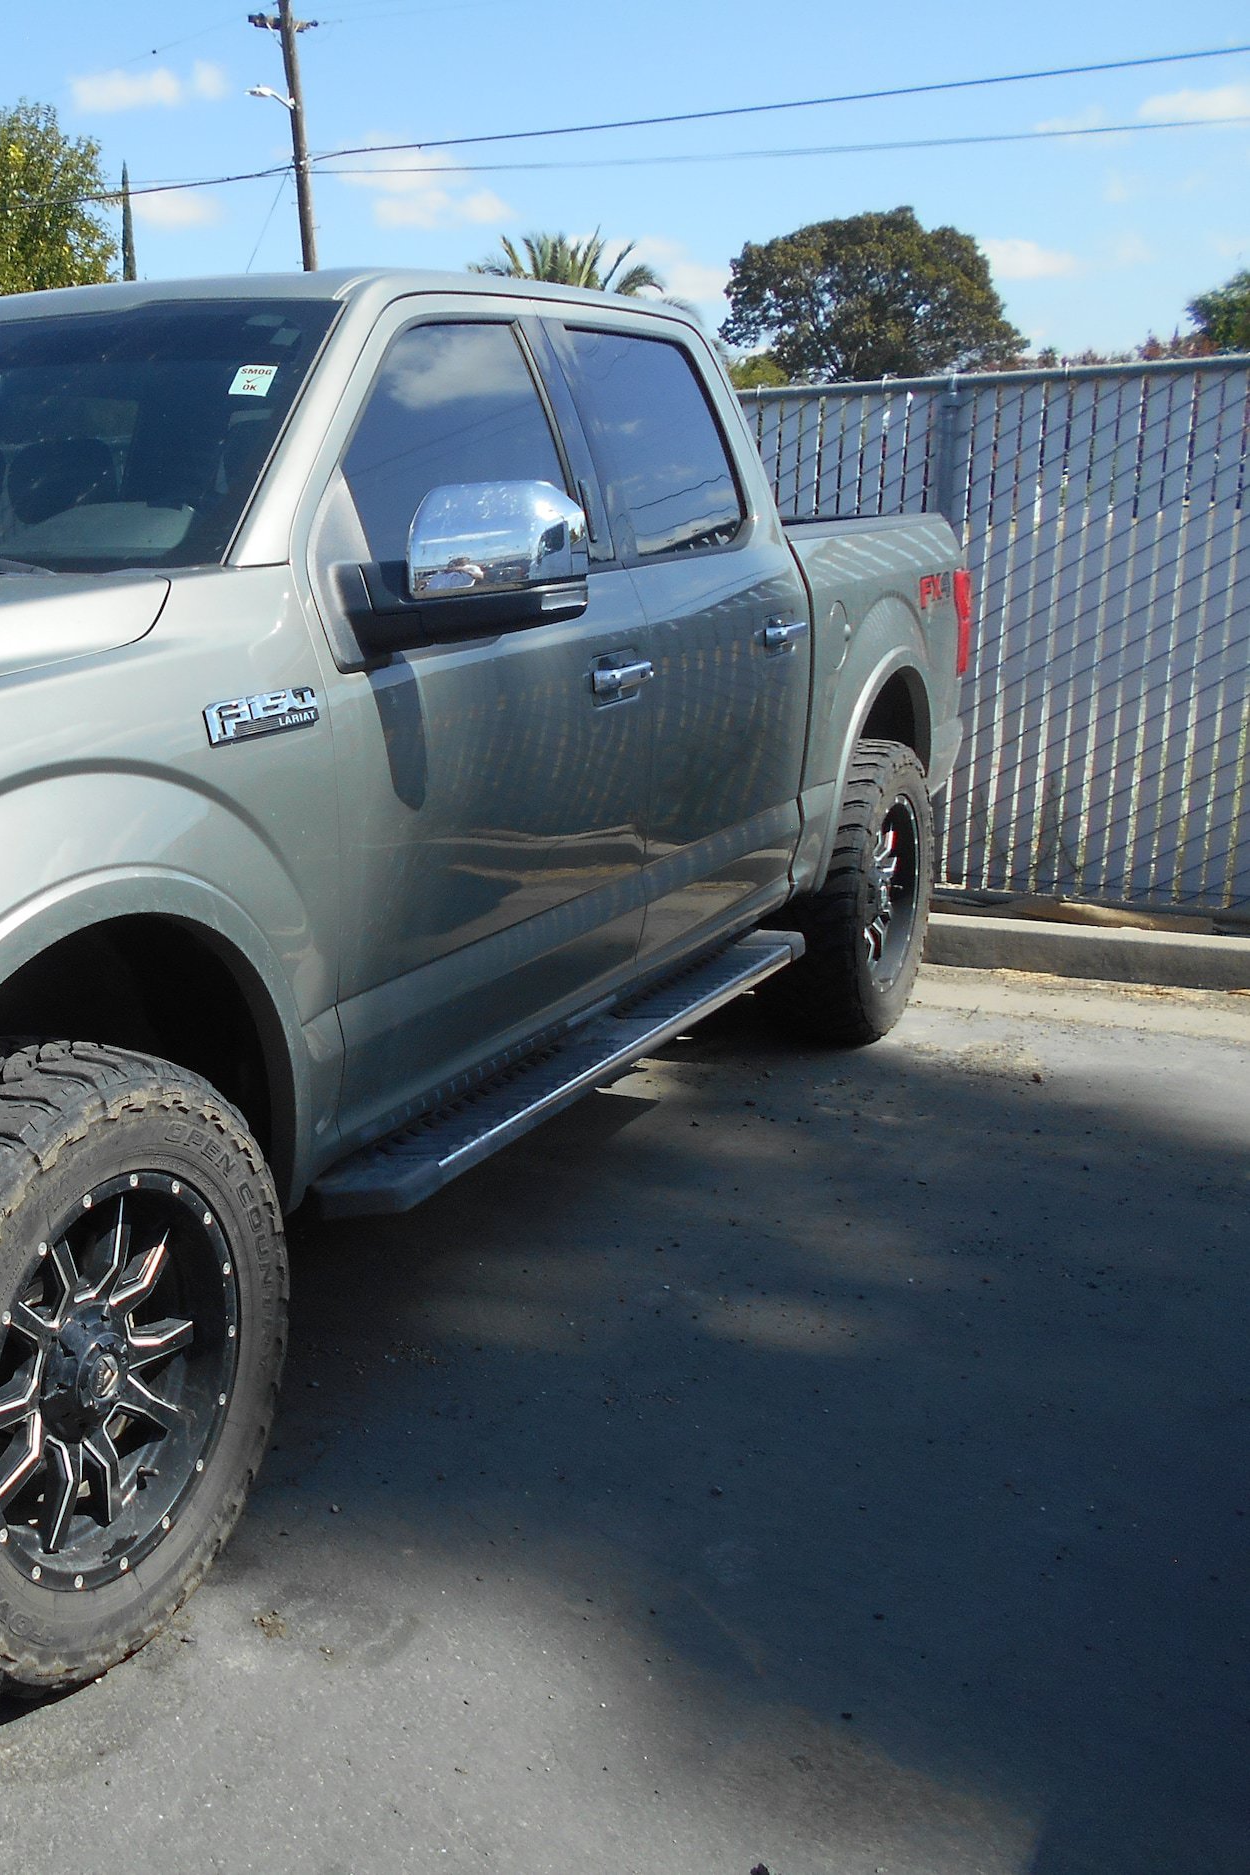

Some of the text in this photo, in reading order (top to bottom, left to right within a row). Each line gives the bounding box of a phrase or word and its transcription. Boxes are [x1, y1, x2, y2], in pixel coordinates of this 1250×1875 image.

[240, 368, 273, 376] SMOG
[278, 710, 316, 727] LARIAT
[162, 1119, 238, 1179] OPEN
